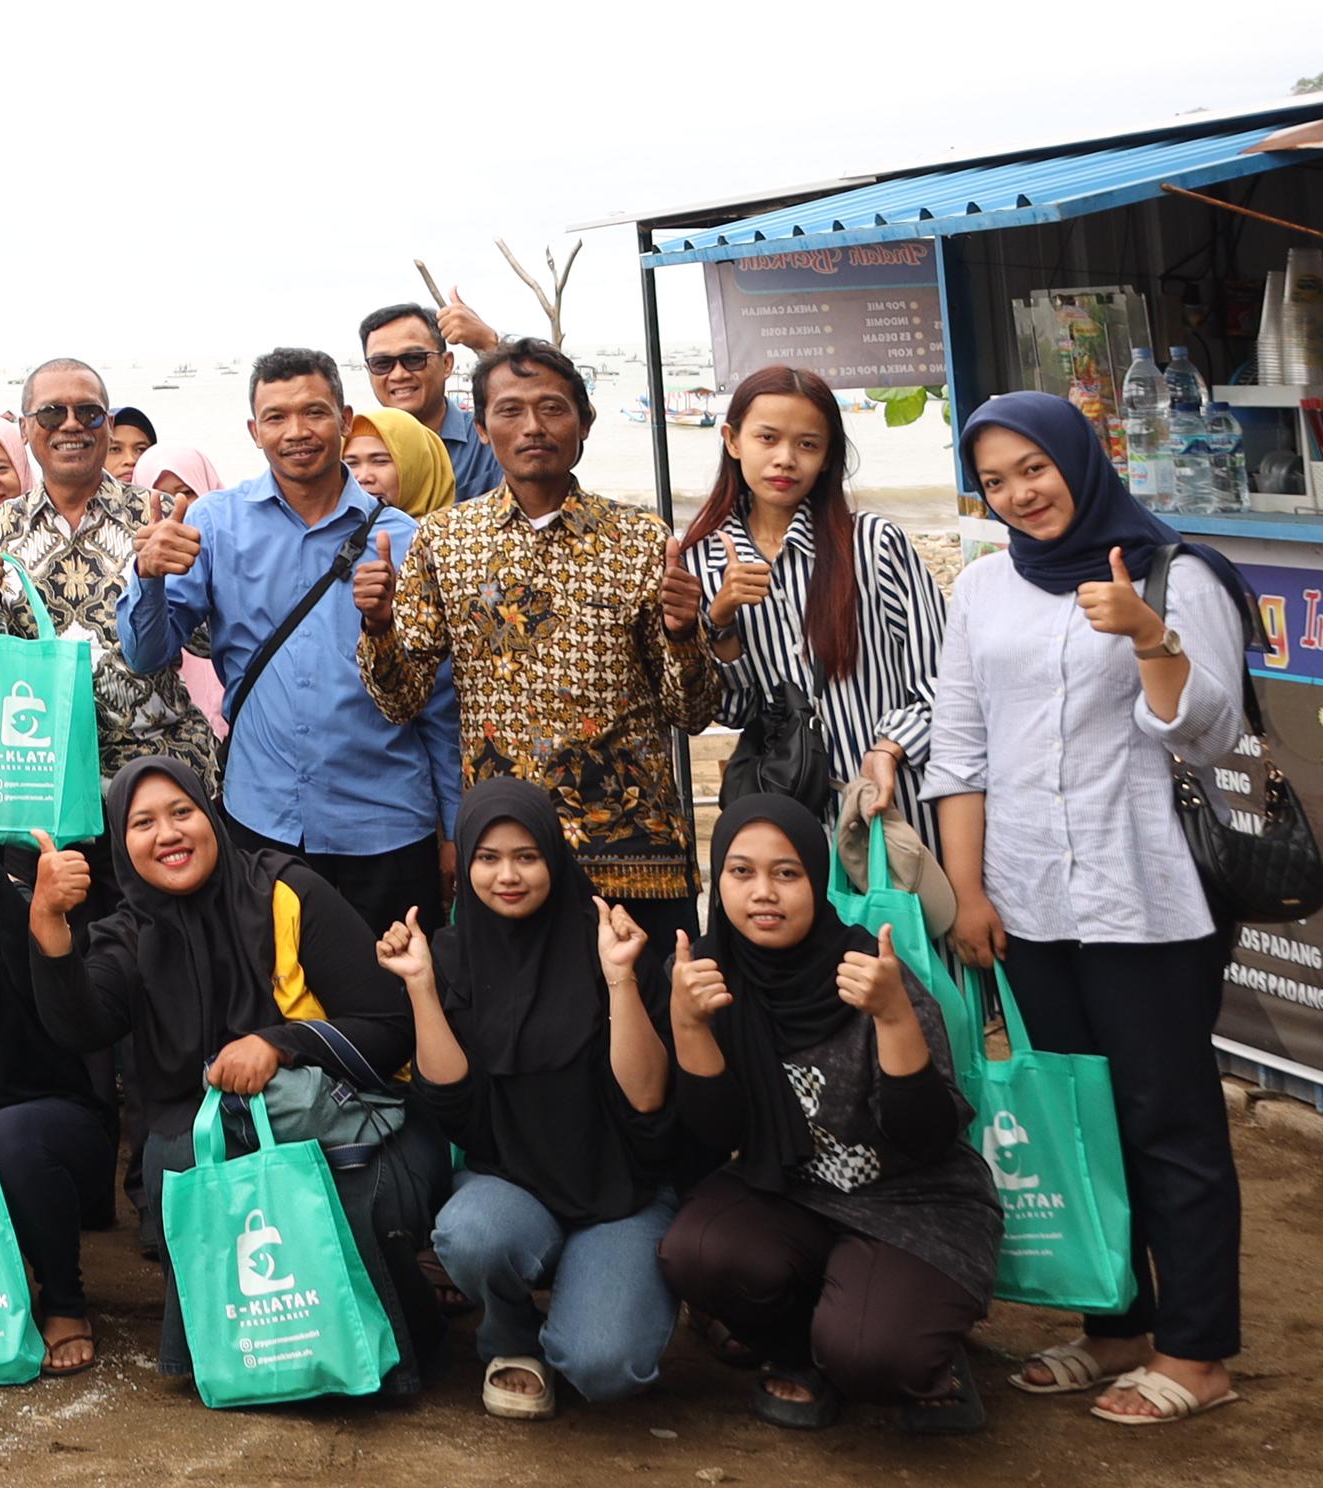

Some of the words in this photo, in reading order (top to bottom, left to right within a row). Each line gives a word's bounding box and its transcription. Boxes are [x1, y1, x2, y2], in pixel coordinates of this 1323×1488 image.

[1260, 931, 1323, 970] PADANG
[1230, 961, 1267, 993] SAOS
[1002, 1192, 1066, 1211] LATAK
[225, 1289, 320, 1320] E-KLATAK
